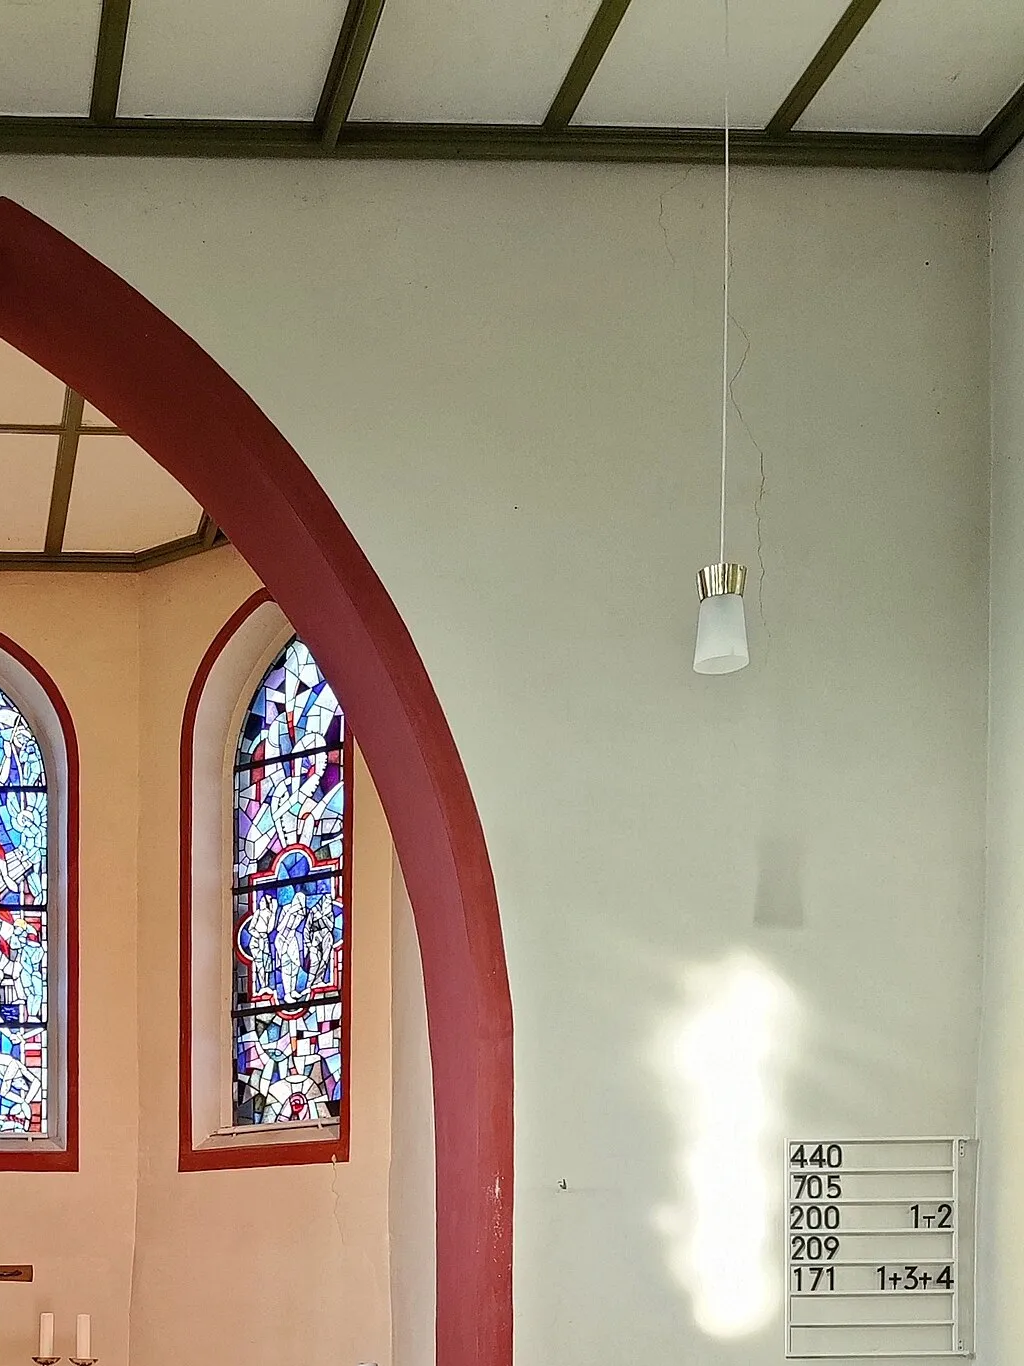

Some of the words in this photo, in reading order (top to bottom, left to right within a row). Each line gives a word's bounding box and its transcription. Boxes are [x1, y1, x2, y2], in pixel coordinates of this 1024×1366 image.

[790, 1144, 842, 1169] 440
[793, 1175, 842, 1199] 705
[789, 1205, 840, 1230] 200
[790, 1236, 840, 1261] 209
[793, 1267, 836, 1292] 171
[876, 1265, 955, 1291] 1+3+4
